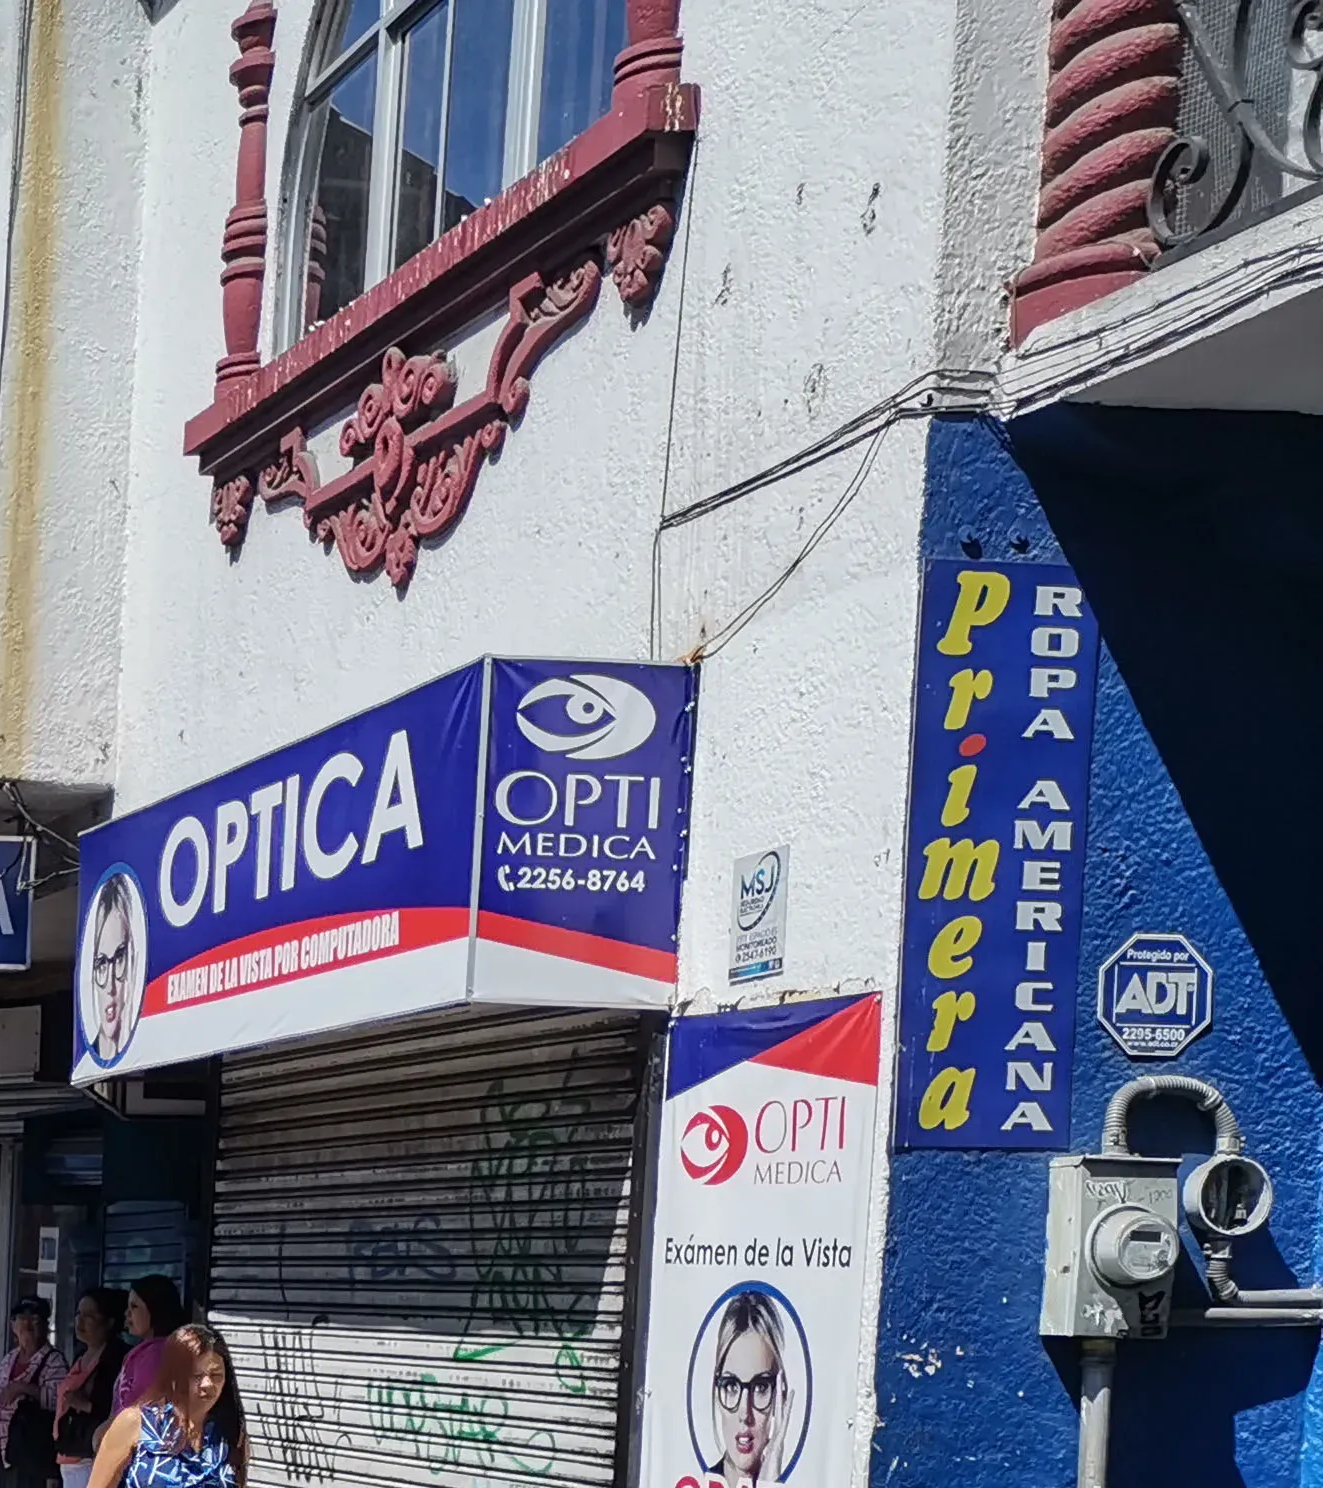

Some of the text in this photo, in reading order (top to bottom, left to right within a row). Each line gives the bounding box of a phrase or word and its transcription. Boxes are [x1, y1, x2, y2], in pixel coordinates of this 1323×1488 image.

[494, 770, 661, 830] OPTI
[159, 729, 424, 927] OPTICA
[497, 832, 657, 860] MEDICA
[917, 570, 1010, 1132] Primera
[1000, 585, 1082, 1132] ROPA AMERICANA
[517, 867, 645, 893] 2256-8764
[740, 862, 775, 900] MSJ
[167, 910, 400, 1004] EXAMEN DE LA VISTA POR COMPUTADORA
[1127, 948, 1190, 963] Protegido por
[1115, 971, 1195, 1015] ADT
[1122, 1028, 1185, 1041] 2295-6500
[755, 1096, 846, 1154] OPTI
[754, 1160, 842, 1185] MEDICA
[665, 1234, 853, 1268] Exámen de la Vista
